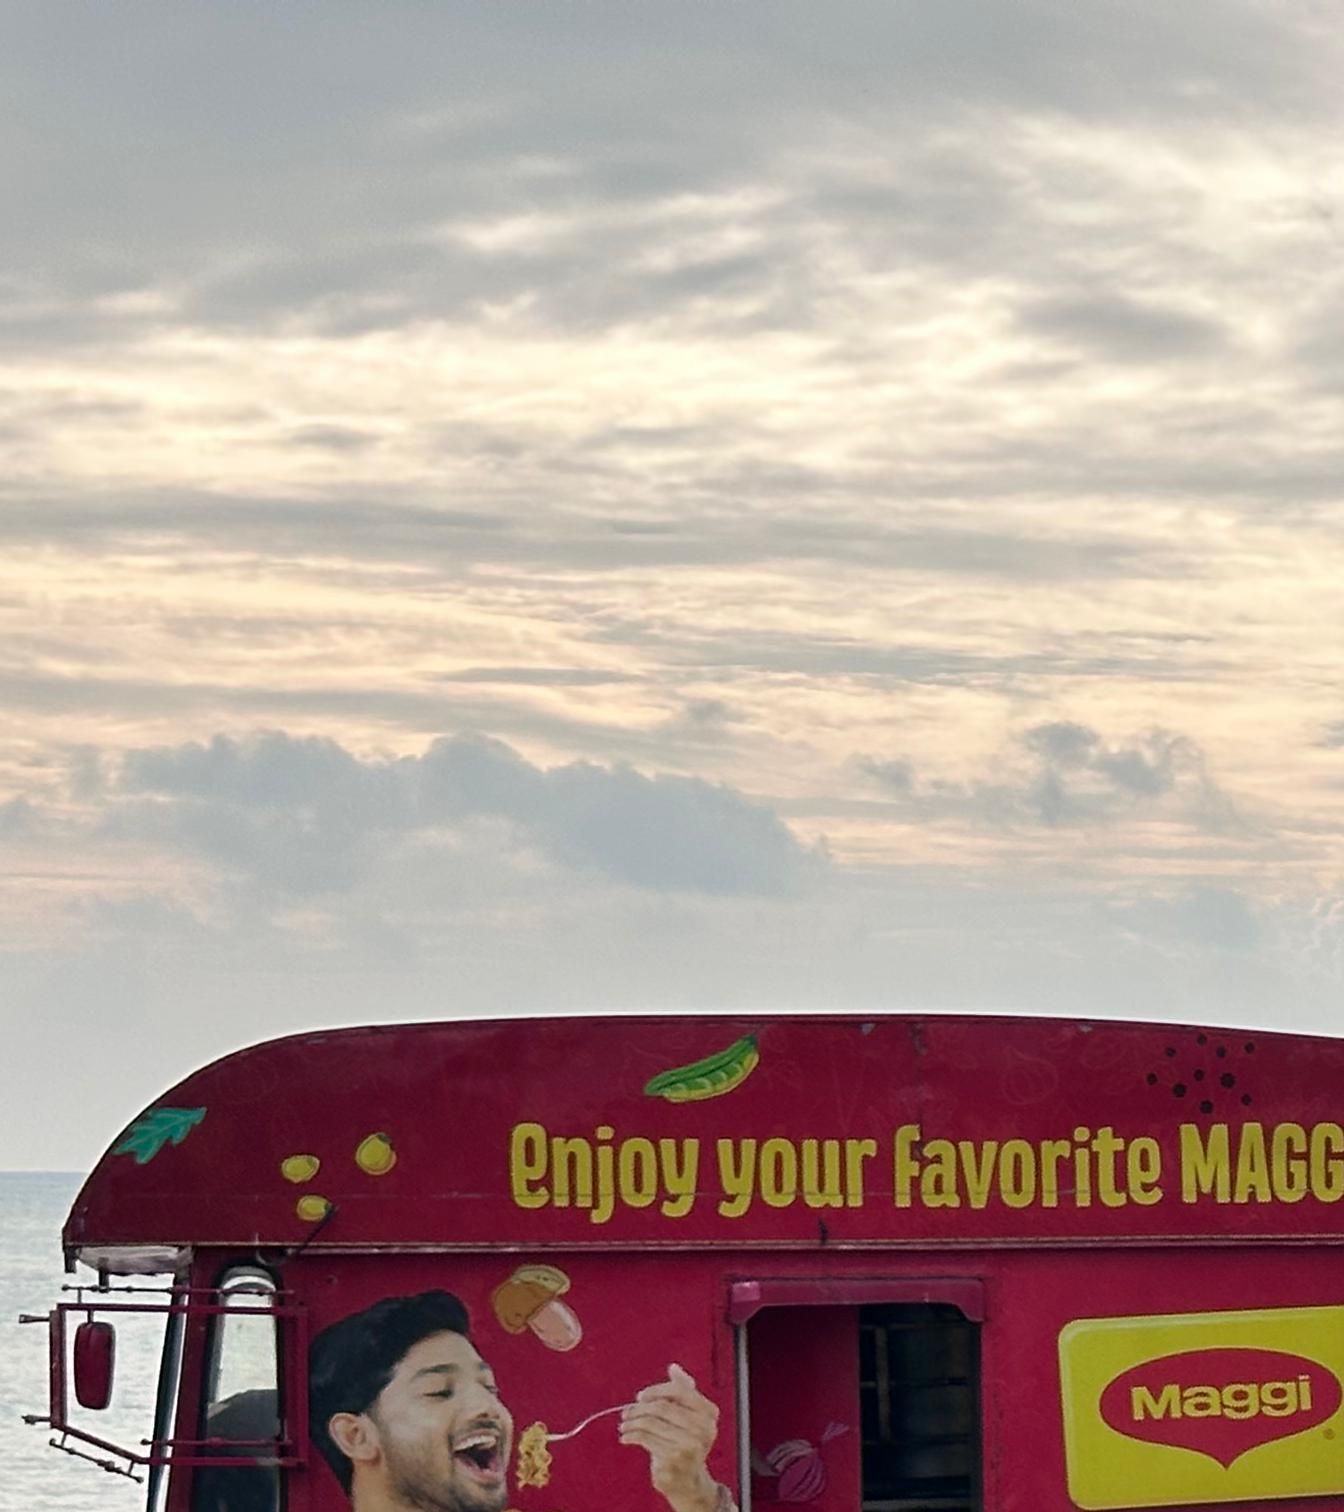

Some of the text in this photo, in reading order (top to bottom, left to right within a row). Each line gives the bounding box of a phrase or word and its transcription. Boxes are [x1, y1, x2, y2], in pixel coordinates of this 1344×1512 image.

[715, 1137, 877, 1218] your
[893, 1122, 1164, 1209] favorite
[1131, 1374, 1312, 1421] Maggi
